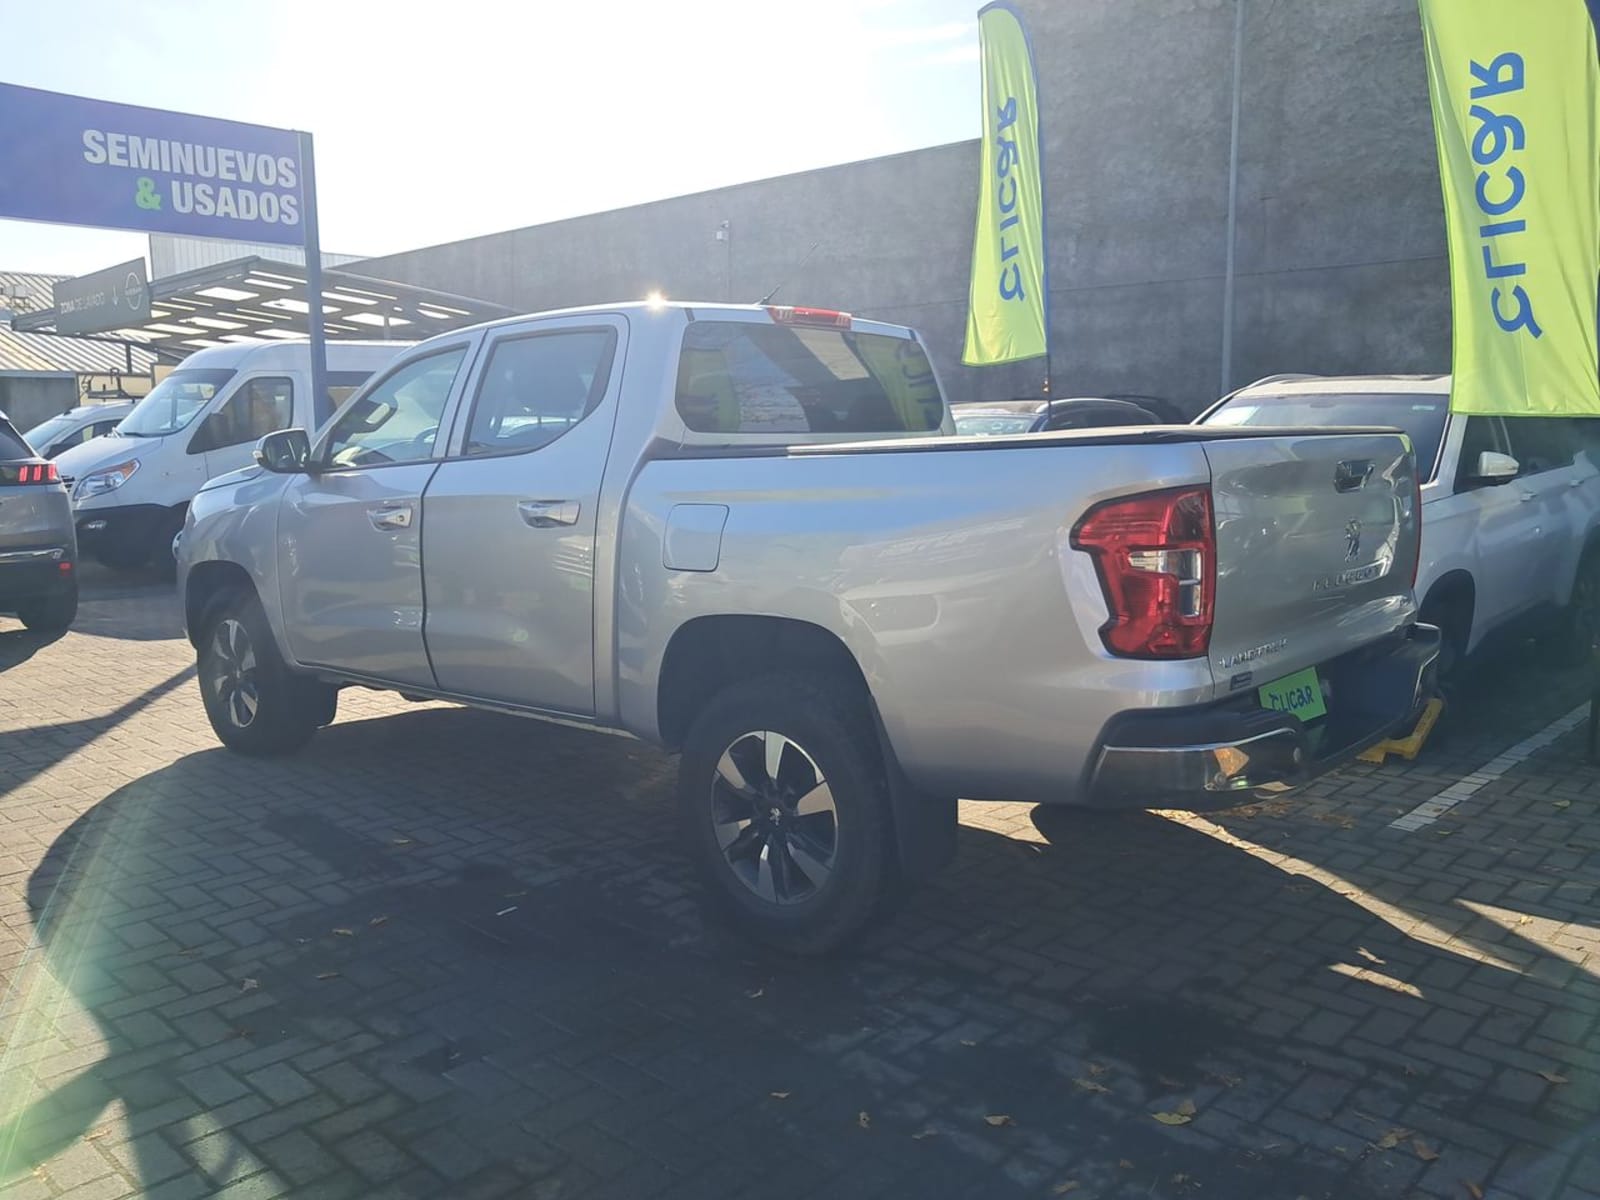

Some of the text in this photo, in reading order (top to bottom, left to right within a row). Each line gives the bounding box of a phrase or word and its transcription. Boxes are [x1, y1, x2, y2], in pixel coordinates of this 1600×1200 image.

[82, 129, 297, 187] SEMINUEVOS
[136, 177, 299, 225] & USADOS
